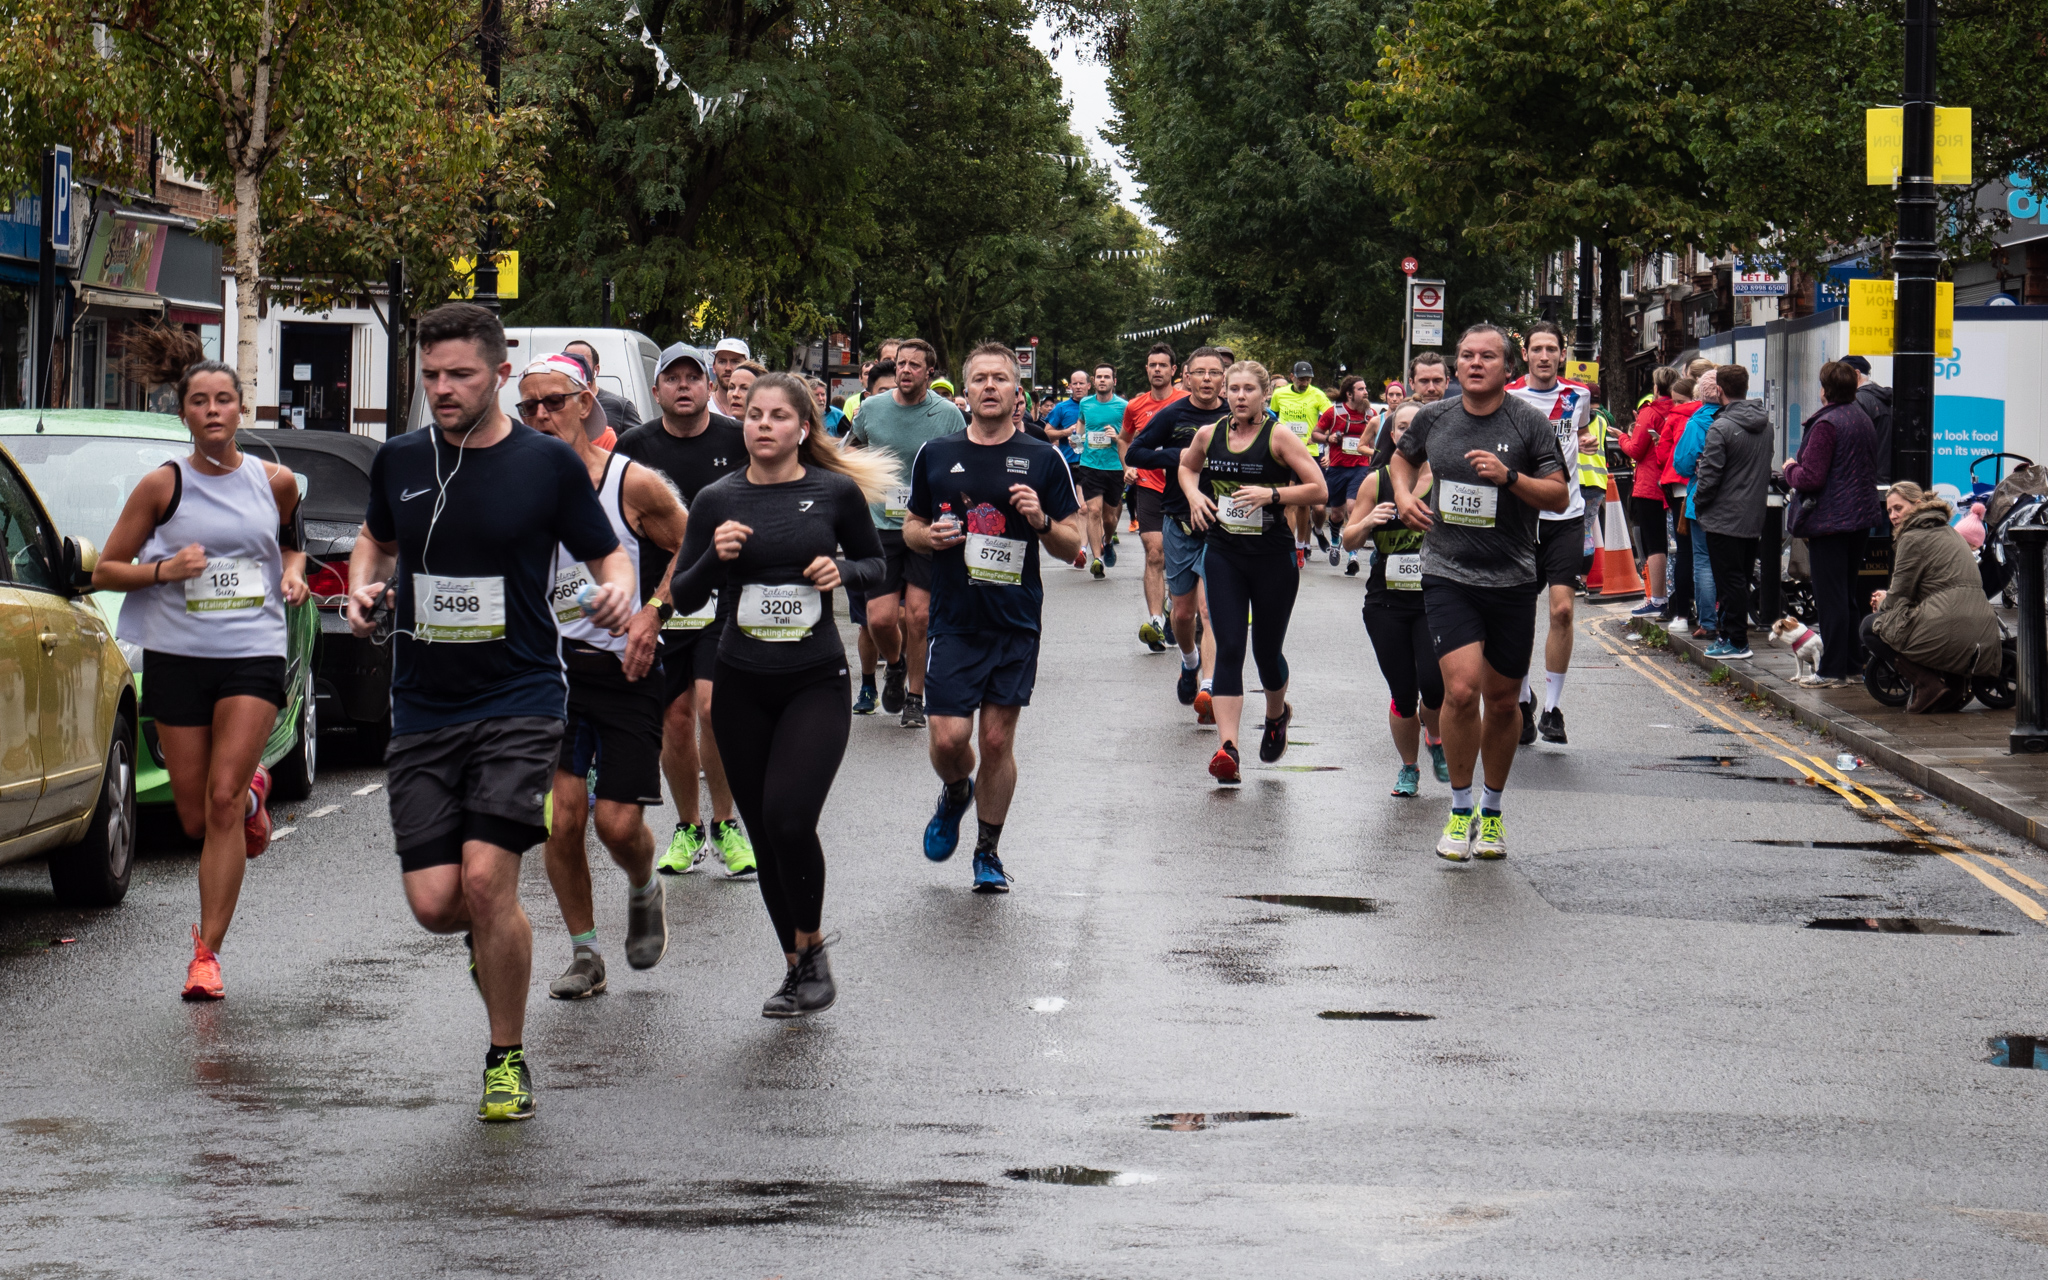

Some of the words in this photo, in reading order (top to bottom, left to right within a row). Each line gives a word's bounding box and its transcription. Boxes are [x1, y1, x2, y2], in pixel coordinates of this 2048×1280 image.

[57, 164, 68, 236] P
[1404, 262, 1415, 270] SK
[1740, 274, 1761, 282] LET
[1945, 429, 1970, 441] look
[1972, 430, 1998, 442] food
[1938, 447, 1952, 455] on
[1955, 445, 1968, 455] its
[1451, 494, 1481, 508] 2115
[1444, 514, 1487, 525] #EalingFeeling
[980, 547, 1011, 562] 5724
[210, 572, 239, 587] 185
[970, 568, 1014, 582] #EalingFeeling
[215, 588, 236, 597] Suzy
[198, 599, 255, 610] #EalingFeeling
[433, 595, 480, 612] 5498
[760, 600, 802, 615] 3208
[774, 616, 790, 624] Tali
[751, 629, 805, 639] #EalingFeelin
